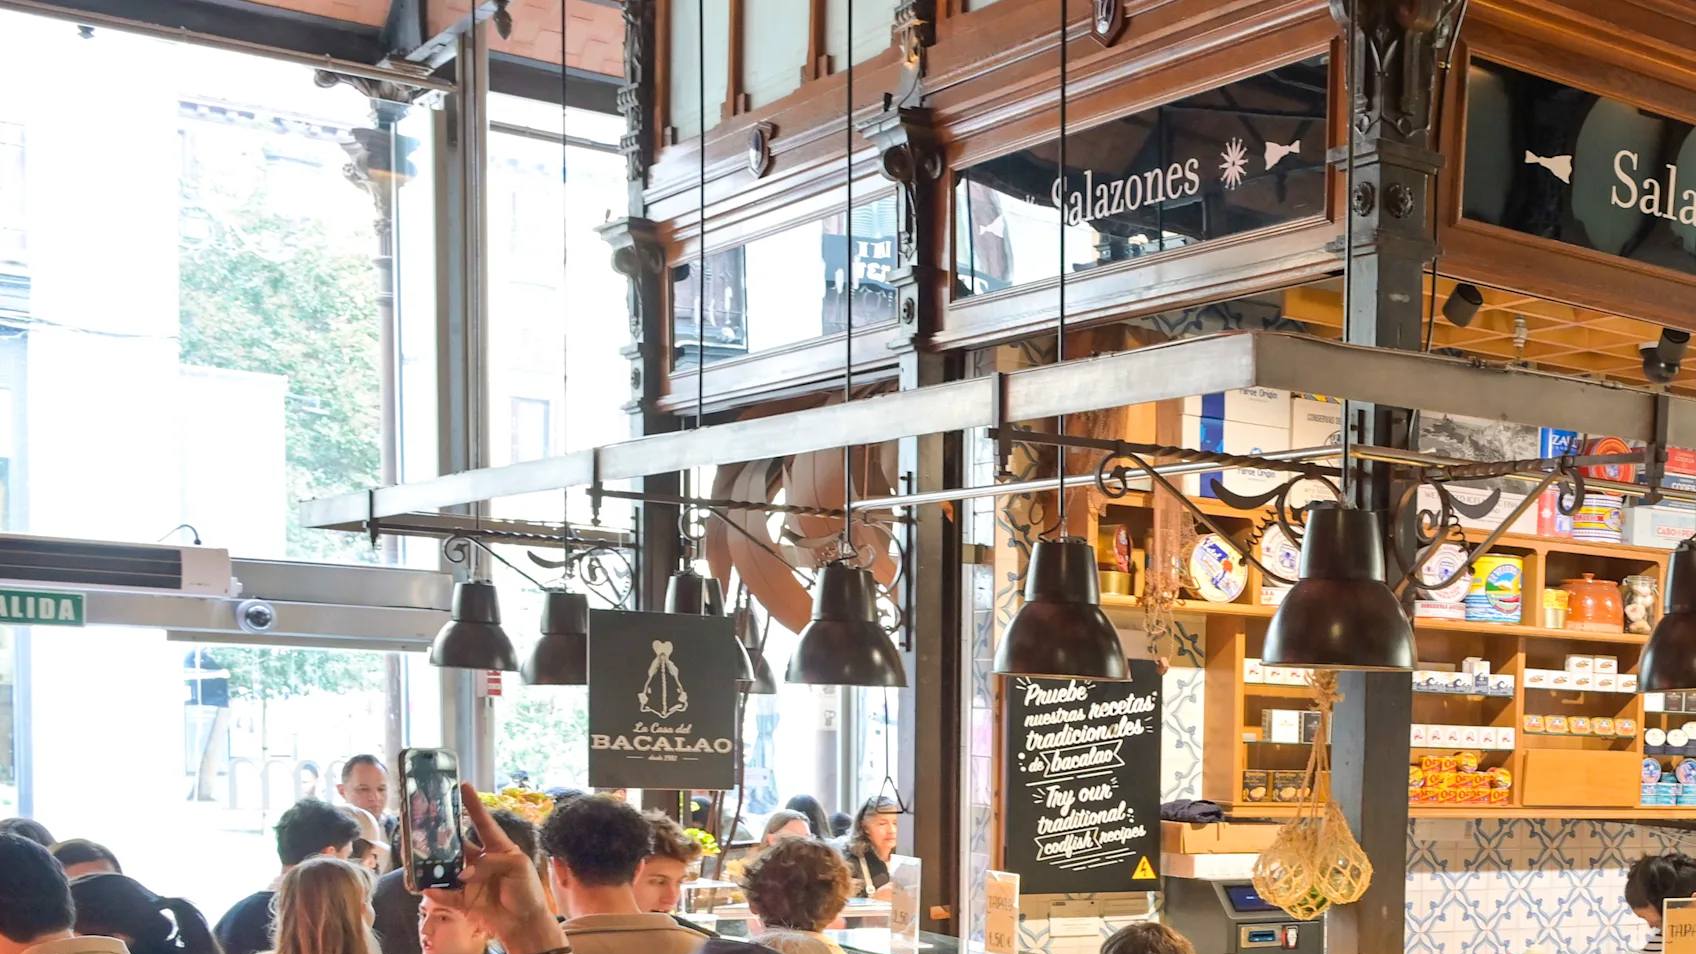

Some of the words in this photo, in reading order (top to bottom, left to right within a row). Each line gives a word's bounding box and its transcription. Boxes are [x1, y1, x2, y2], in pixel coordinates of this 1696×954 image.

[1051, 157, 1200, 227] Salazones
[0, 595, 76, 620] ALIDA
[1024, 679, 1088, 706] Pruebe
[1024, 708, 1086, 727] nuestras
[1088, 693, 1155, 720] recetas
[591, 734, 733, 754] BACALAO
[633, 722, 649, 733] La
[1025, 715, 1144, 751] tradicionales
[1028, 757, 1044, 773] de
[1051, 746, 1113, 772] bacalao
[1046, 785, 1076, 817] Try
[1078, 783, 1113, 803] our
[1037, 800, 1126, 835] traditional
[1044, 831, 1094, 858] codfish
[1099, 825, 1147, 845] recipes
